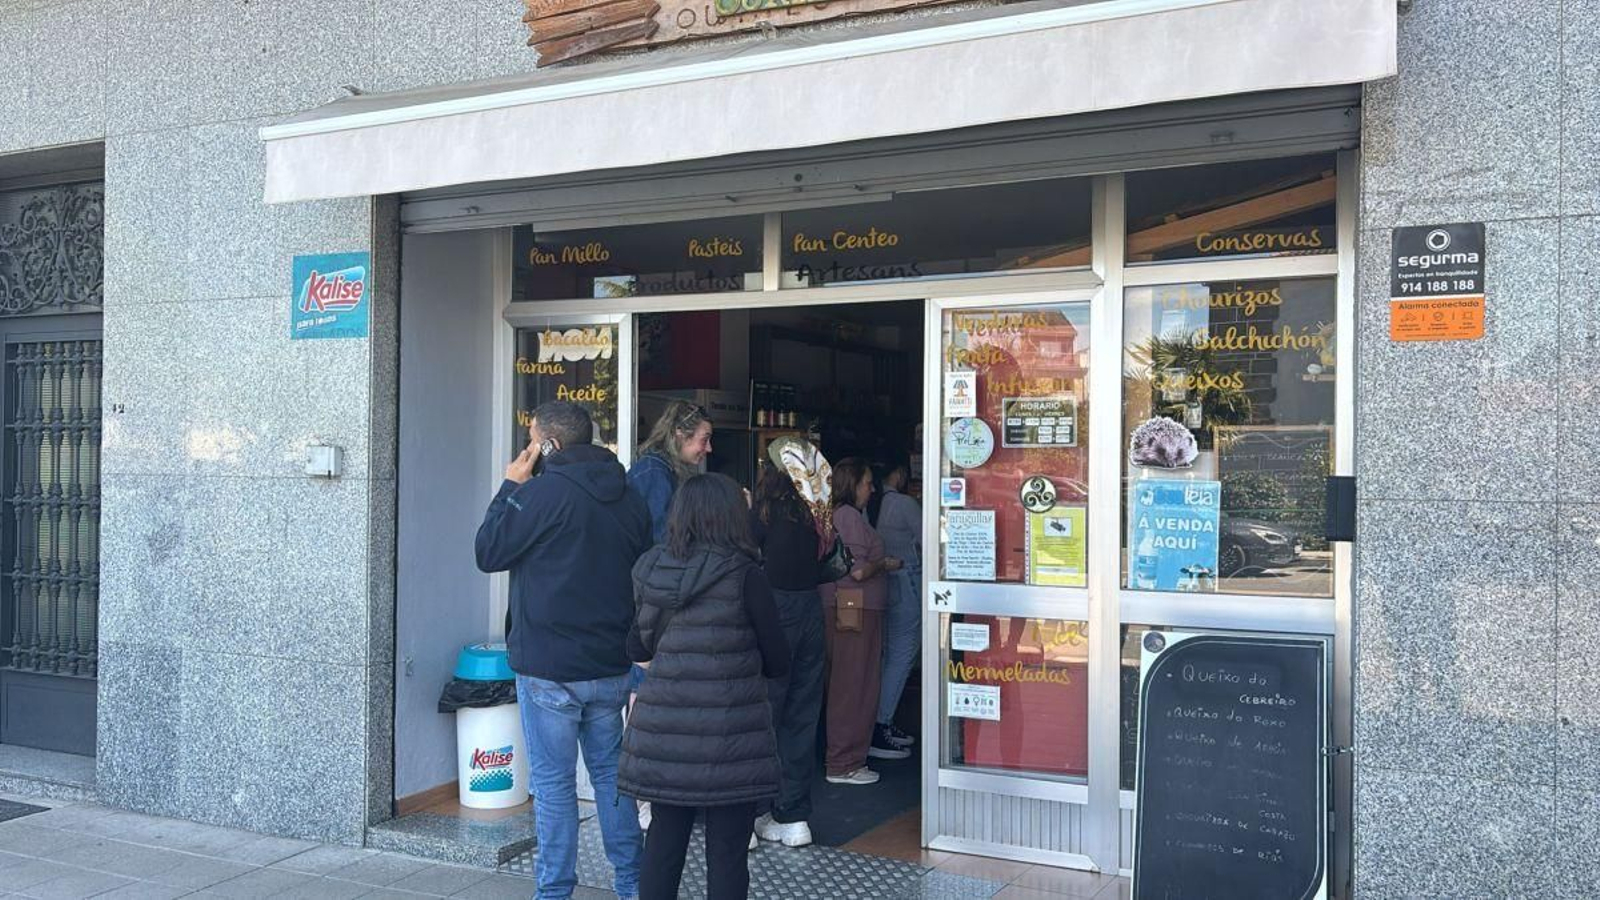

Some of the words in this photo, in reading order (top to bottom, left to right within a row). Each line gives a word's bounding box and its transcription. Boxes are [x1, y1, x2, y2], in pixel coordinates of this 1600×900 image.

[688, 236, 743, 257] Pasteis
[793, 233, 826, 252] Pan
[832, 227, 898, 249] Centeo
[1196, 228, 1322, 252] Conservas
[529, 247, 558, 265] Pan
[561, 242, 610, 265] Millo
[1398, 252, 1479, 269] segurma
[303, 270, 364, 312] Kalise
[1401, 282, 1422, 293] 914
[1427, 281, 1448, 291] 188
[1453, 279, 1474, 290] 188
[1161, 286, 1284, 316] Chourizos
[556, 383, 608, 401] Aceite
[1020, 401, 1061, 410] HORARIO
[1155, 517, 1214, 533] VENDA
[1154, 535, 1197, 550] AQUÍ
[947, 659, 1071, 685] Mermeladas
[472, 748, 513, 771] Kalise
